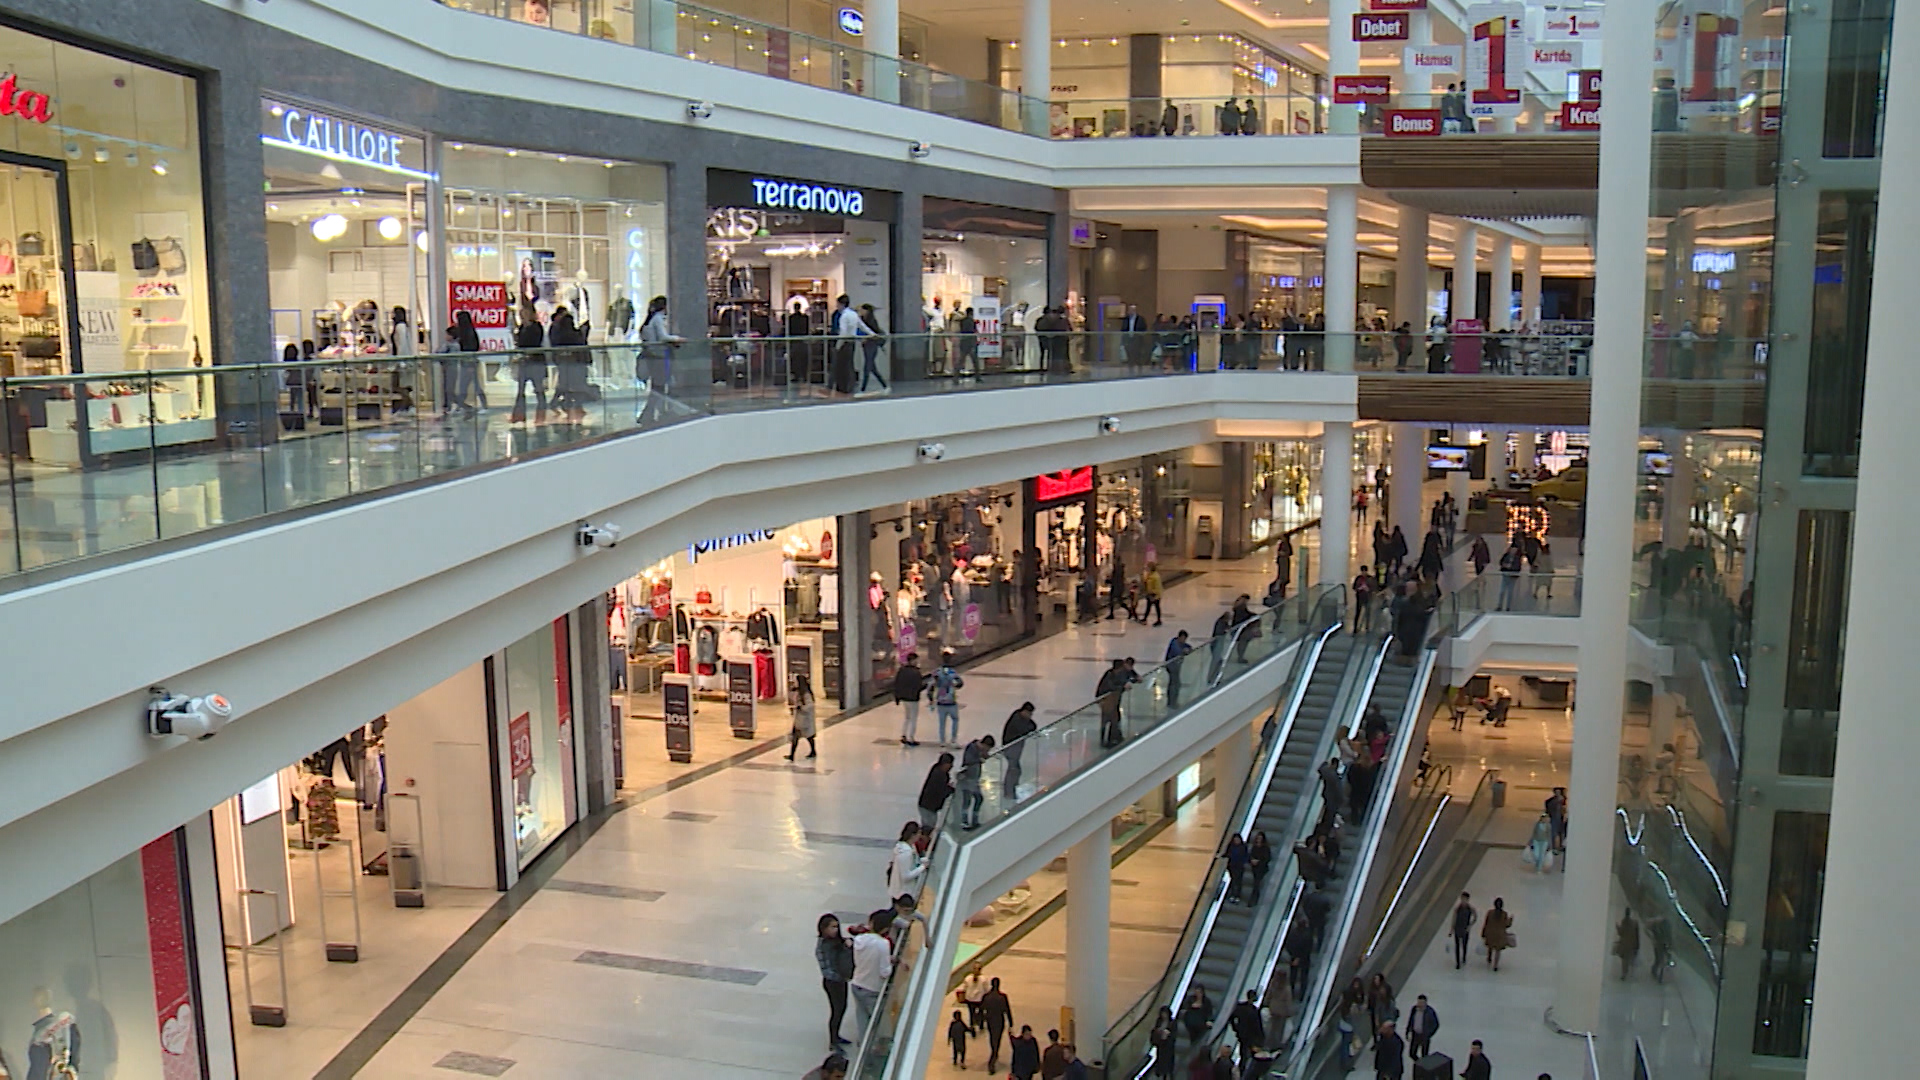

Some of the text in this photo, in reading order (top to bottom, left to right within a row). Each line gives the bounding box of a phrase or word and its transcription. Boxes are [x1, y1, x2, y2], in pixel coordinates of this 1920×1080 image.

[1360, 18, 1403, 36] Debet
[1472, 15, 1521, 104] 1
[1534, 49, 1572, 62] Kartda
[1392, 114, 1434, 132] Bonus
[283, 109, 401, 167] CALLIOPE
[454, 285, 503, 302] SMART
[665, 713, 689, 726] 10%
